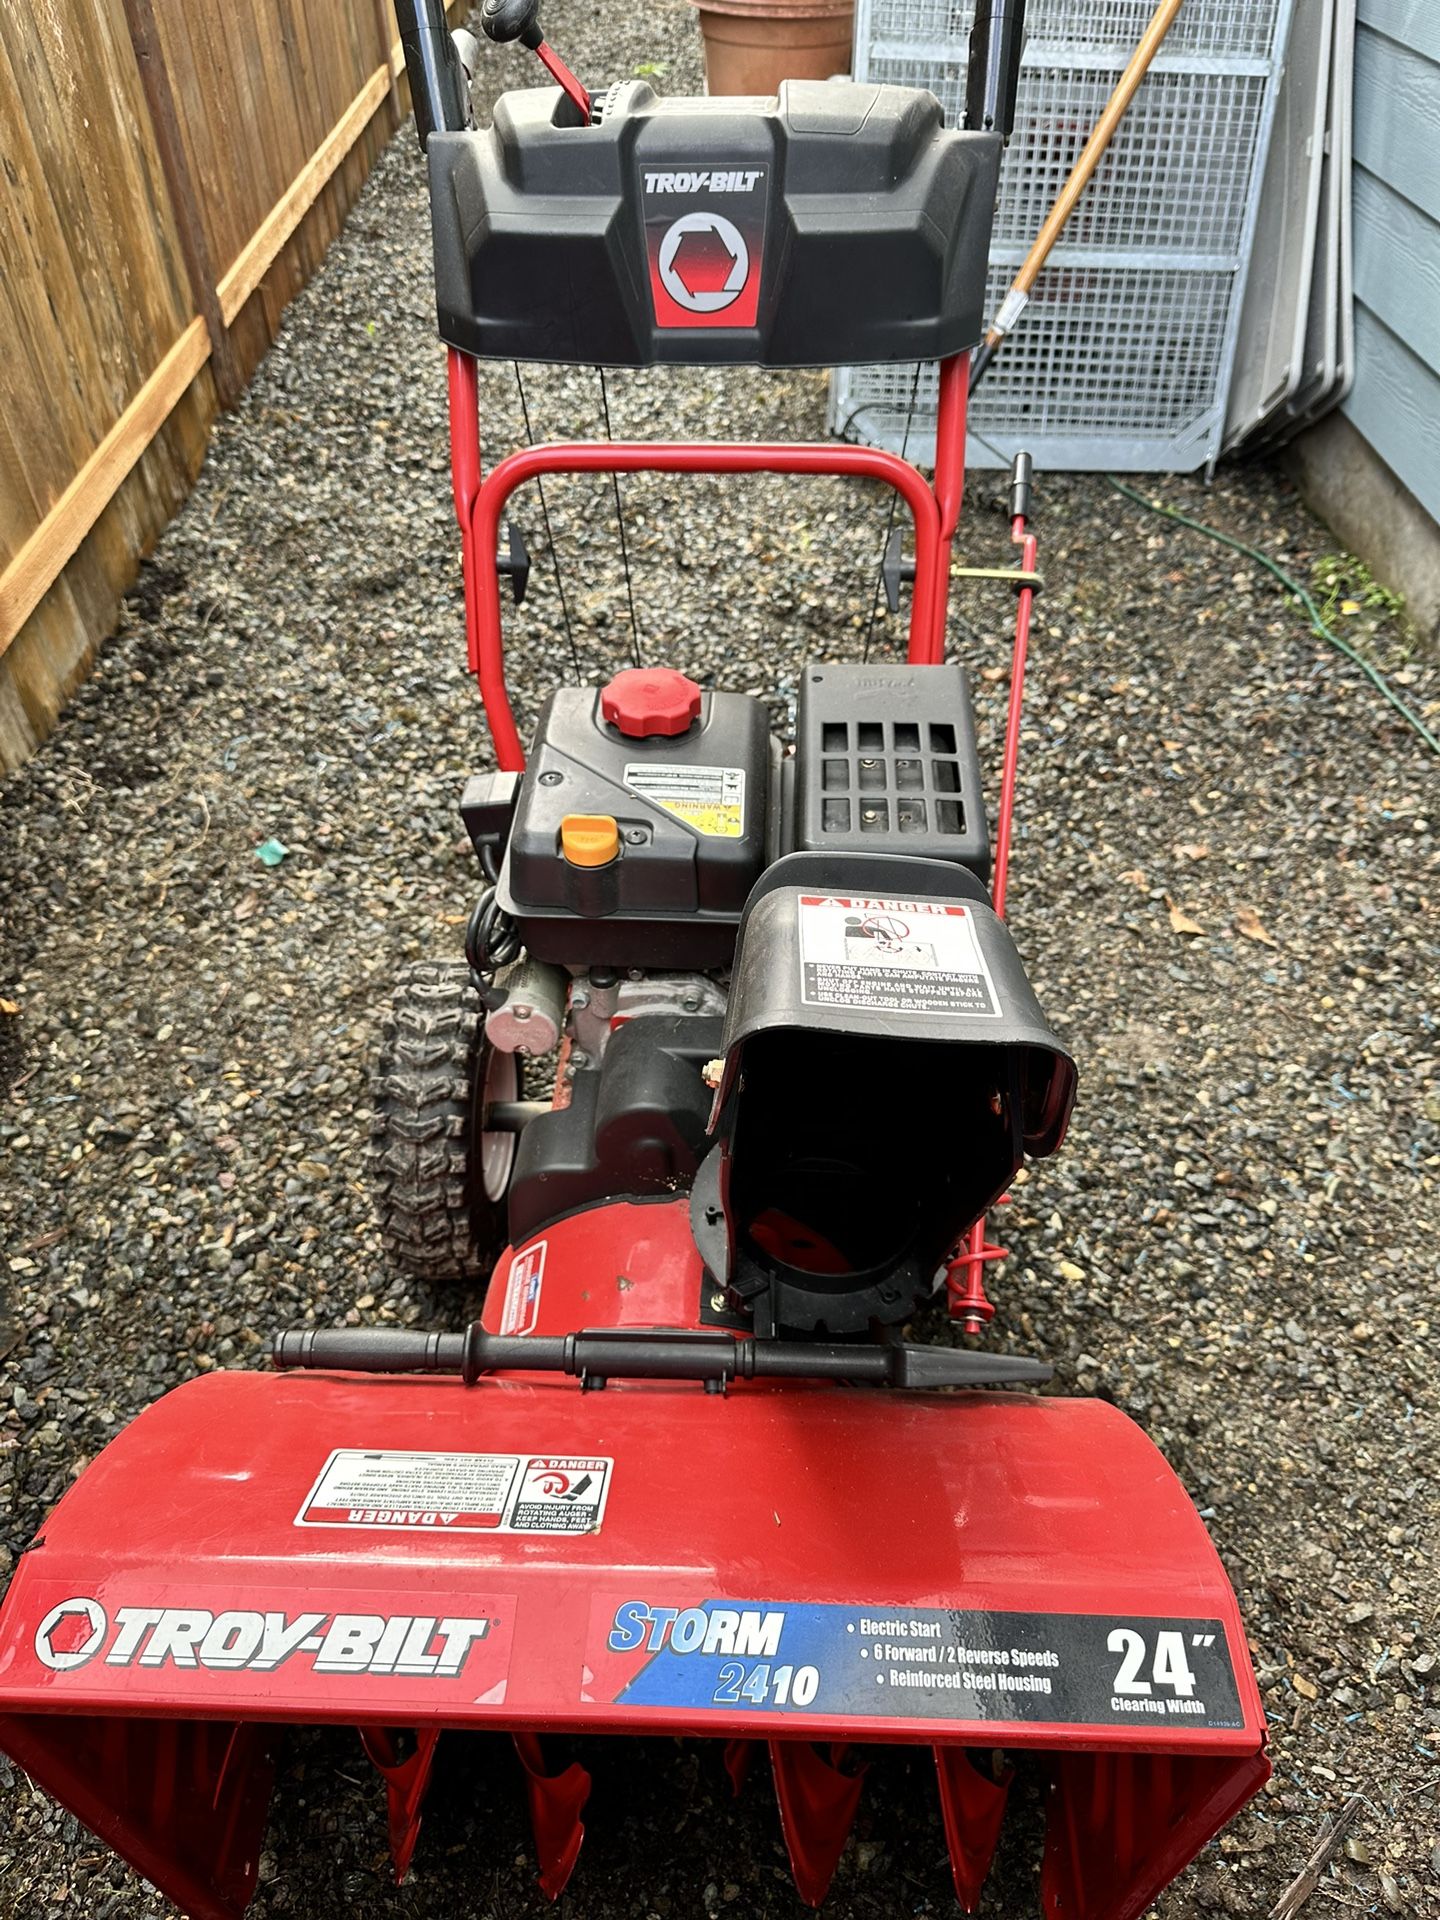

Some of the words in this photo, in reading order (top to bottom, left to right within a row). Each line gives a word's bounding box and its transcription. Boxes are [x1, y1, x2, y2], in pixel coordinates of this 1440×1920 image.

[644, 172, 761, 193] TROY-BILT
[850, 899, 947, 914] DANGER
[549, 1460, 605, 1469] DANGER
[348, 1509, 437, 1524] DANGER
[608, 1601, 786, 1656] STORM
[860, 1619, 908, 1636] Electric
[910, 1621, 941, 1637] Start
[104, 1607, 490, 1677] TROY-BILT
[874, 1643, 882, 1660] 6
[885, 1644, 936, 1662] Forward
[939, 1647, 944, 1663] /
[947, 1647, 955, 1663] 2
[958, 1647, 1009, 1665] Reverse
[1012, 1649, 1059, 1667] Speeds
[713, 1662, 820, 1706] 2410
[890, 1670, 960, 1688] Reinforced
[963, 1672, 996, 1690] Steel
[998, 1673, 1052, 1694] Housing
[1111, 1697, 1165, 1714] Clearing
[1166, 1698, 1206, 1714] Width
